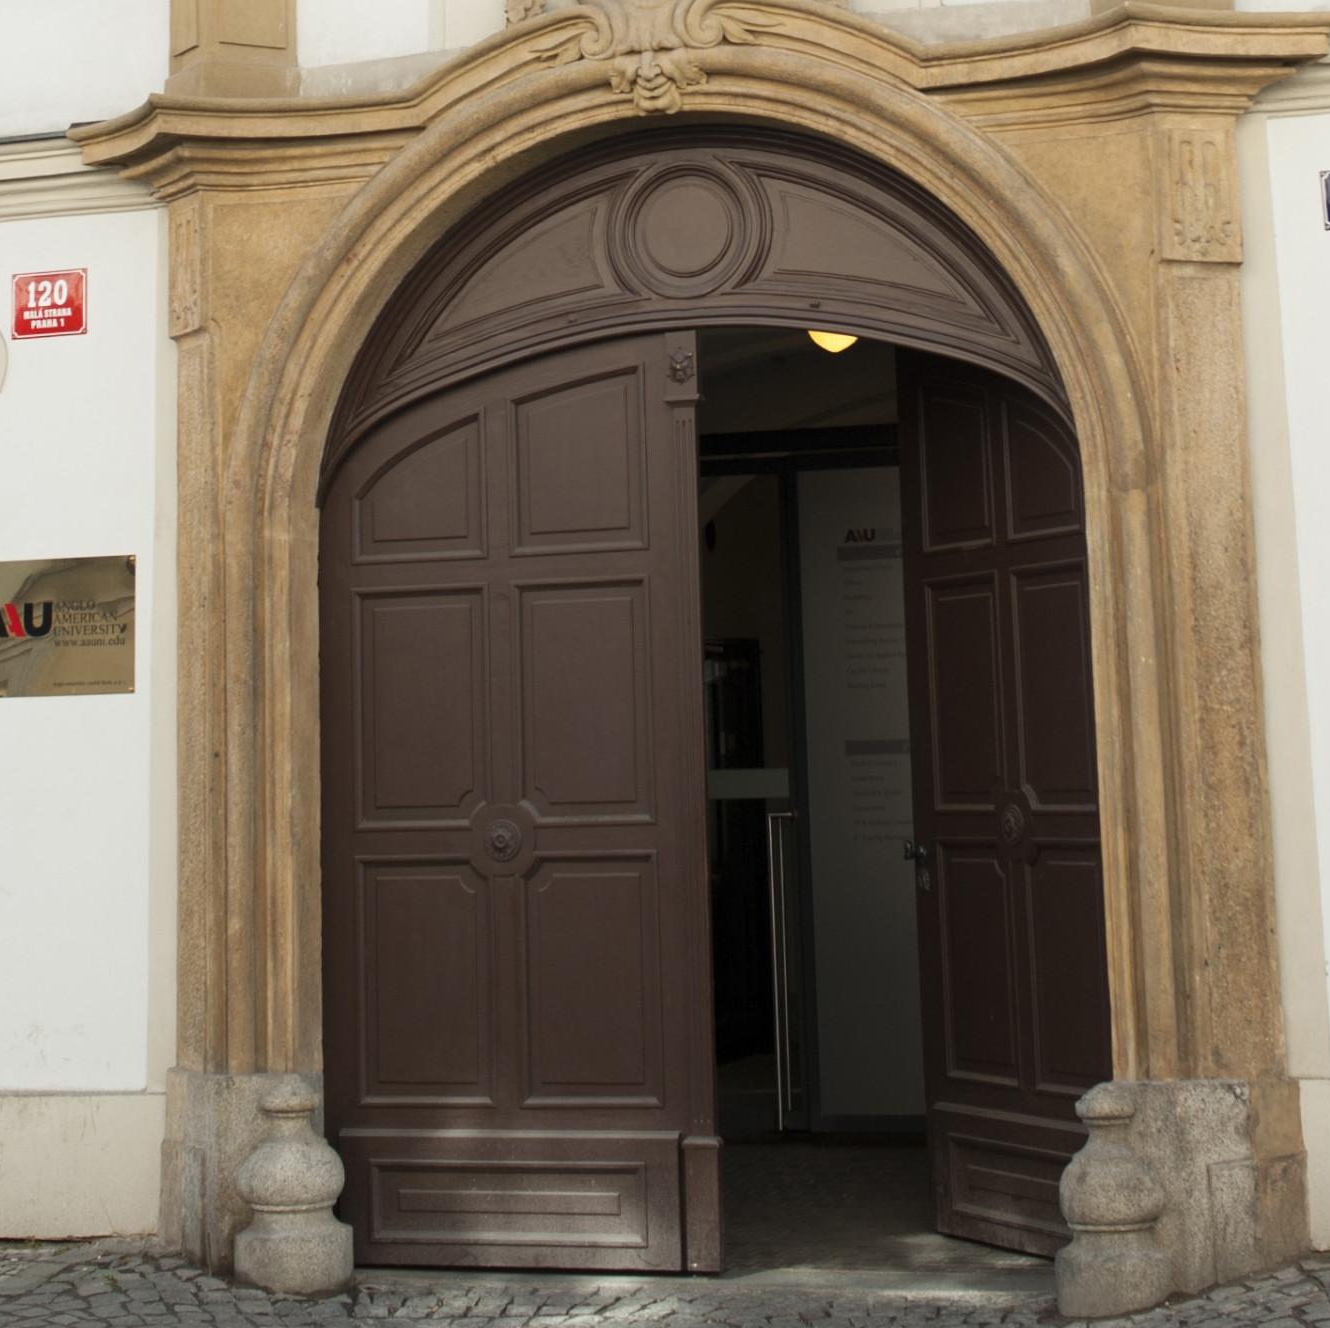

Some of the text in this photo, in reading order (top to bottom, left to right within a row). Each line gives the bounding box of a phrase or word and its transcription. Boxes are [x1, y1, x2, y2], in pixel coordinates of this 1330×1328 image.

[28, 280, 68, 307] 120
[30, 319, 58, 330] PRAHA
[54, 600, 96, 612] ANGLO
[53, 611, 118, 624] AMERICAN
[53, 624, 128, 637] UNIVERSITY
